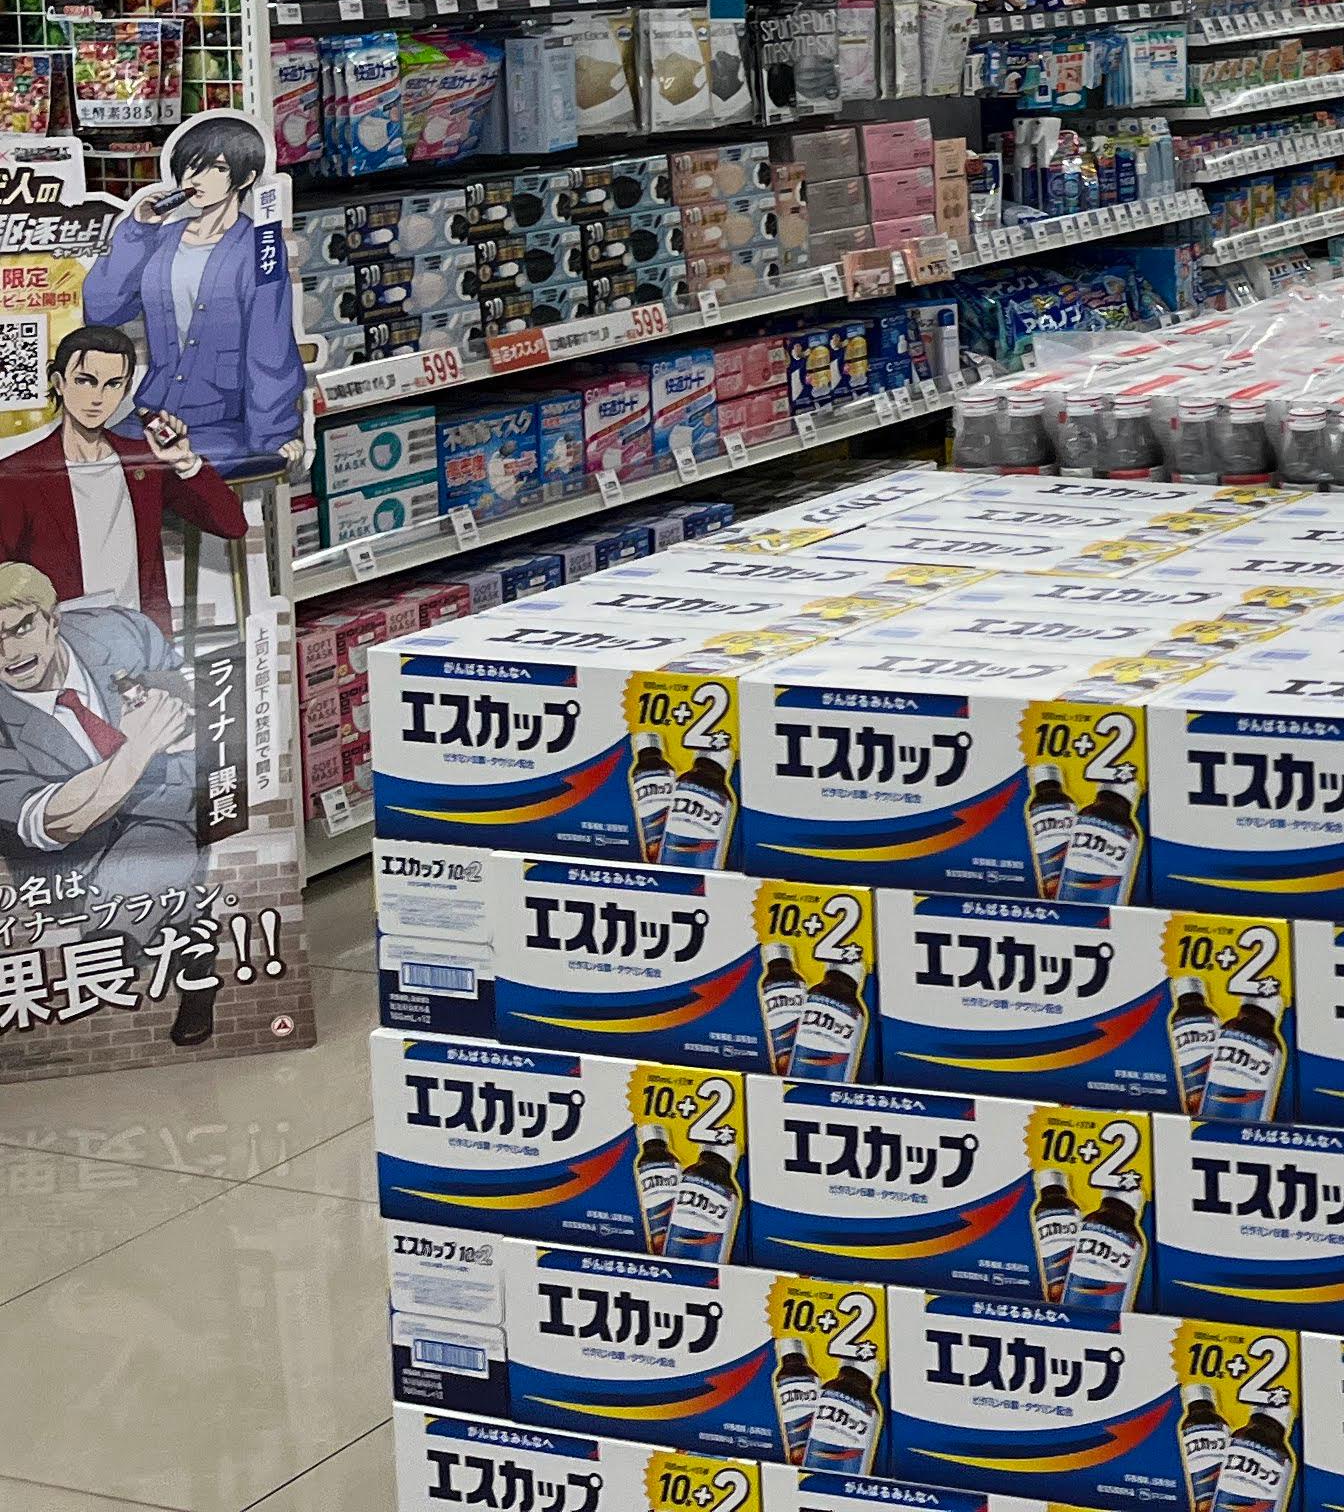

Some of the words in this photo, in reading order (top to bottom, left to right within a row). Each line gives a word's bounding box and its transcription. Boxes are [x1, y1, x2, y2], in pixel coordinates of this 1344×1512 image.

[260, 188, 278, 219] 部下
[52, 246, 113, 259] キャンペーン
[260, 229, 278, 276] ミカサ
[2, 267, 49, 289] 限定
[632, 305, 665, 337] 599
[422, 350, 459, 385] 599
[334, 459, 367, 473] MASK
[487, 625, 681, 651] エスカップ
[443, 662, 532, 680] がんばるみんなへ
[822, 693, 920, 711] がんばるみんなへ
[401, 690, 582, 754] エスカップ
[1236, 718, 1341, 737] がんばるみんなへ
[206, 658, 239, 827] ライナー課長
[775, 722, 973, 787] エスカップ
[381, 855, 444, 879] エスカップ
[569, 868, 659, 888] がんばるみんなへ
[961, 901, 1059, 923] がんばるみんなへ
[524, 896, 709, 963] エスカップ
[914, 930, 1114, 999] エスカップ
[404, 1073, 586, 1142] エスカップ
[783, 1119, 979, 1189] エスカップ
[393, 1233, 457, 1262] エスカップ
[537, 1283, 724, 1354] エスカップ
[924, 1326, 1125, 1401] エスカップ
